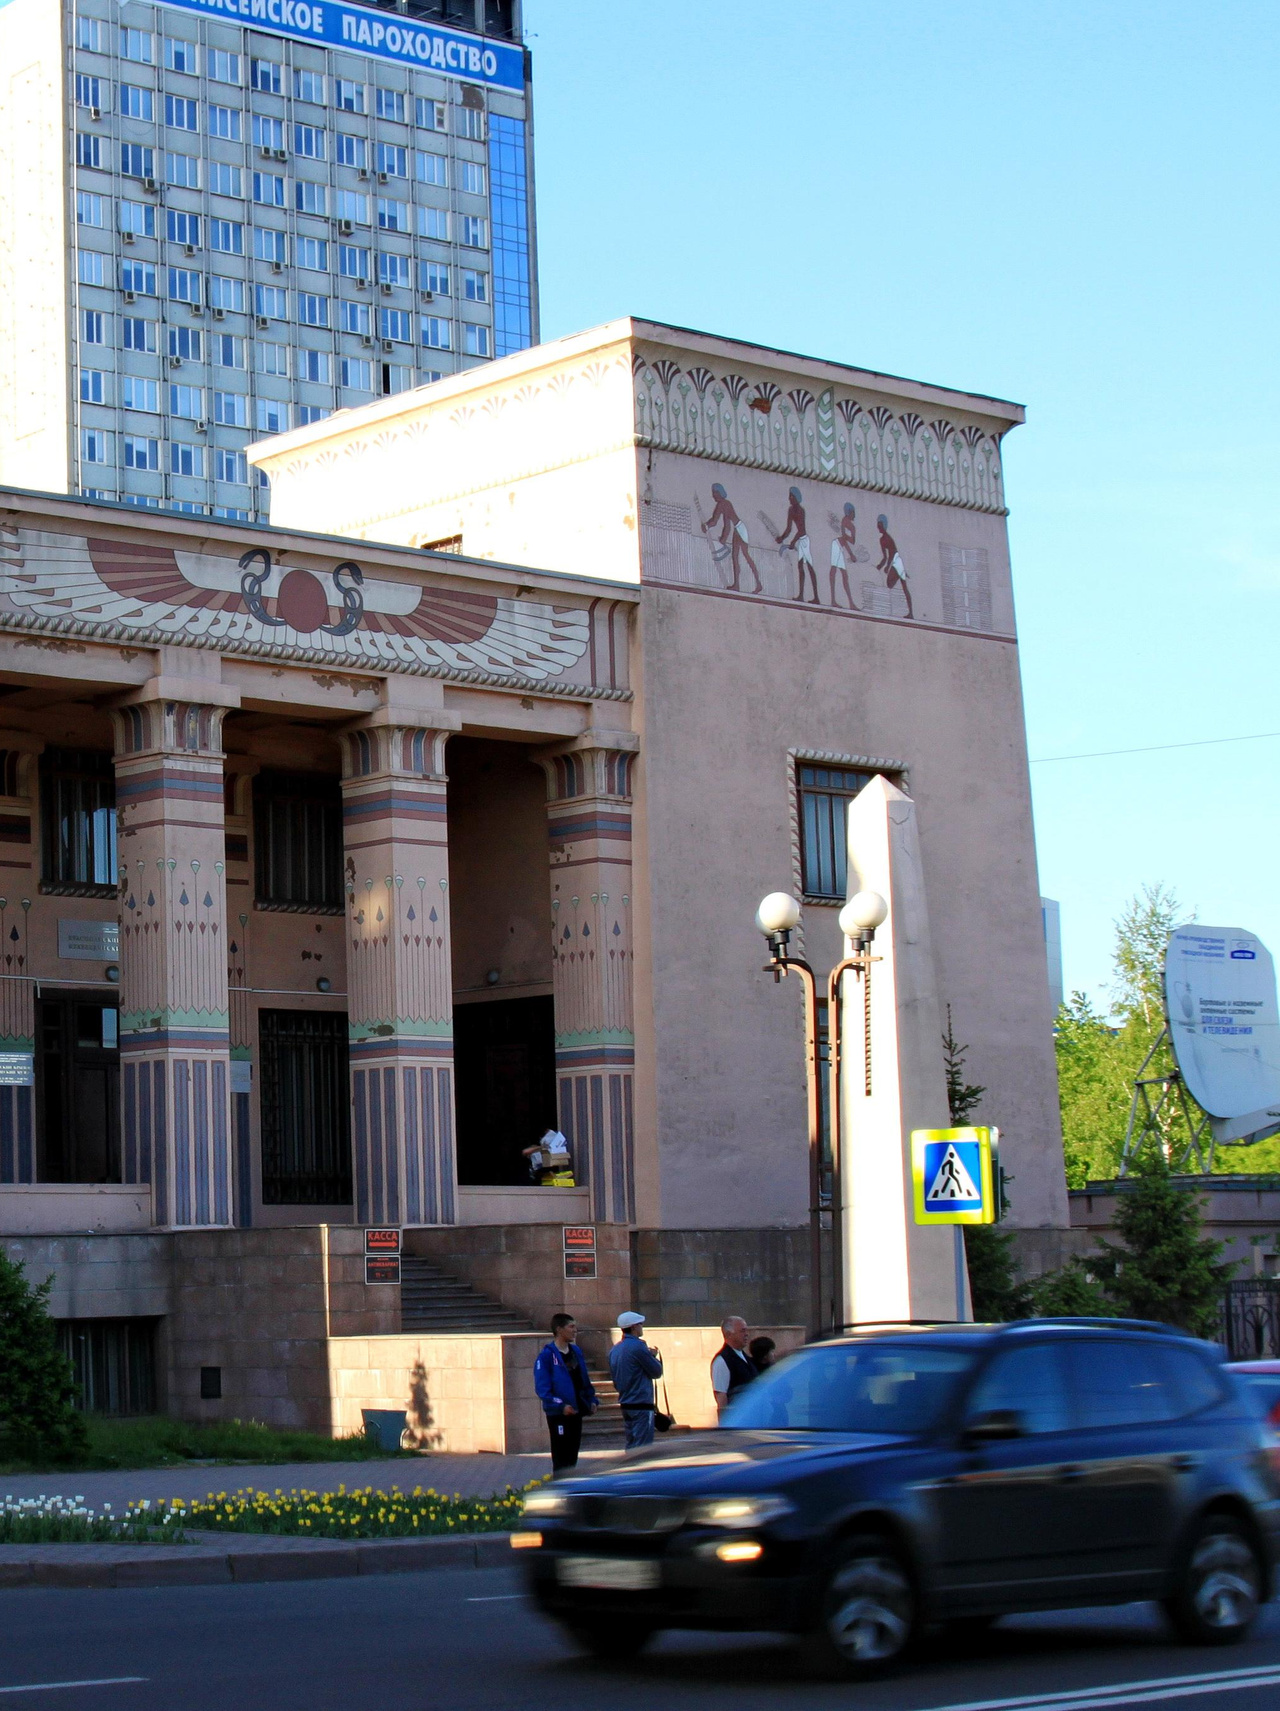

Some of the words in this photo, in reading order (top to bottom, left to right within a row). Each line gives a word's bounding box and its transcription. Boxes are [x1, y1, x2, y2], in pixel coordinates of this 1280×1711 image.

[191, 0, 323, 33] СЕЙСКОЕ
[342, 14, 497, 76] ПАРОХОДСТВО
[1208, 1027, 1252, 1035] ТЕЛЕВИДЕНИЯ
[368, 1231, 398, 1240] КАССА
[565, 1229, 593, 1238] КАССА
